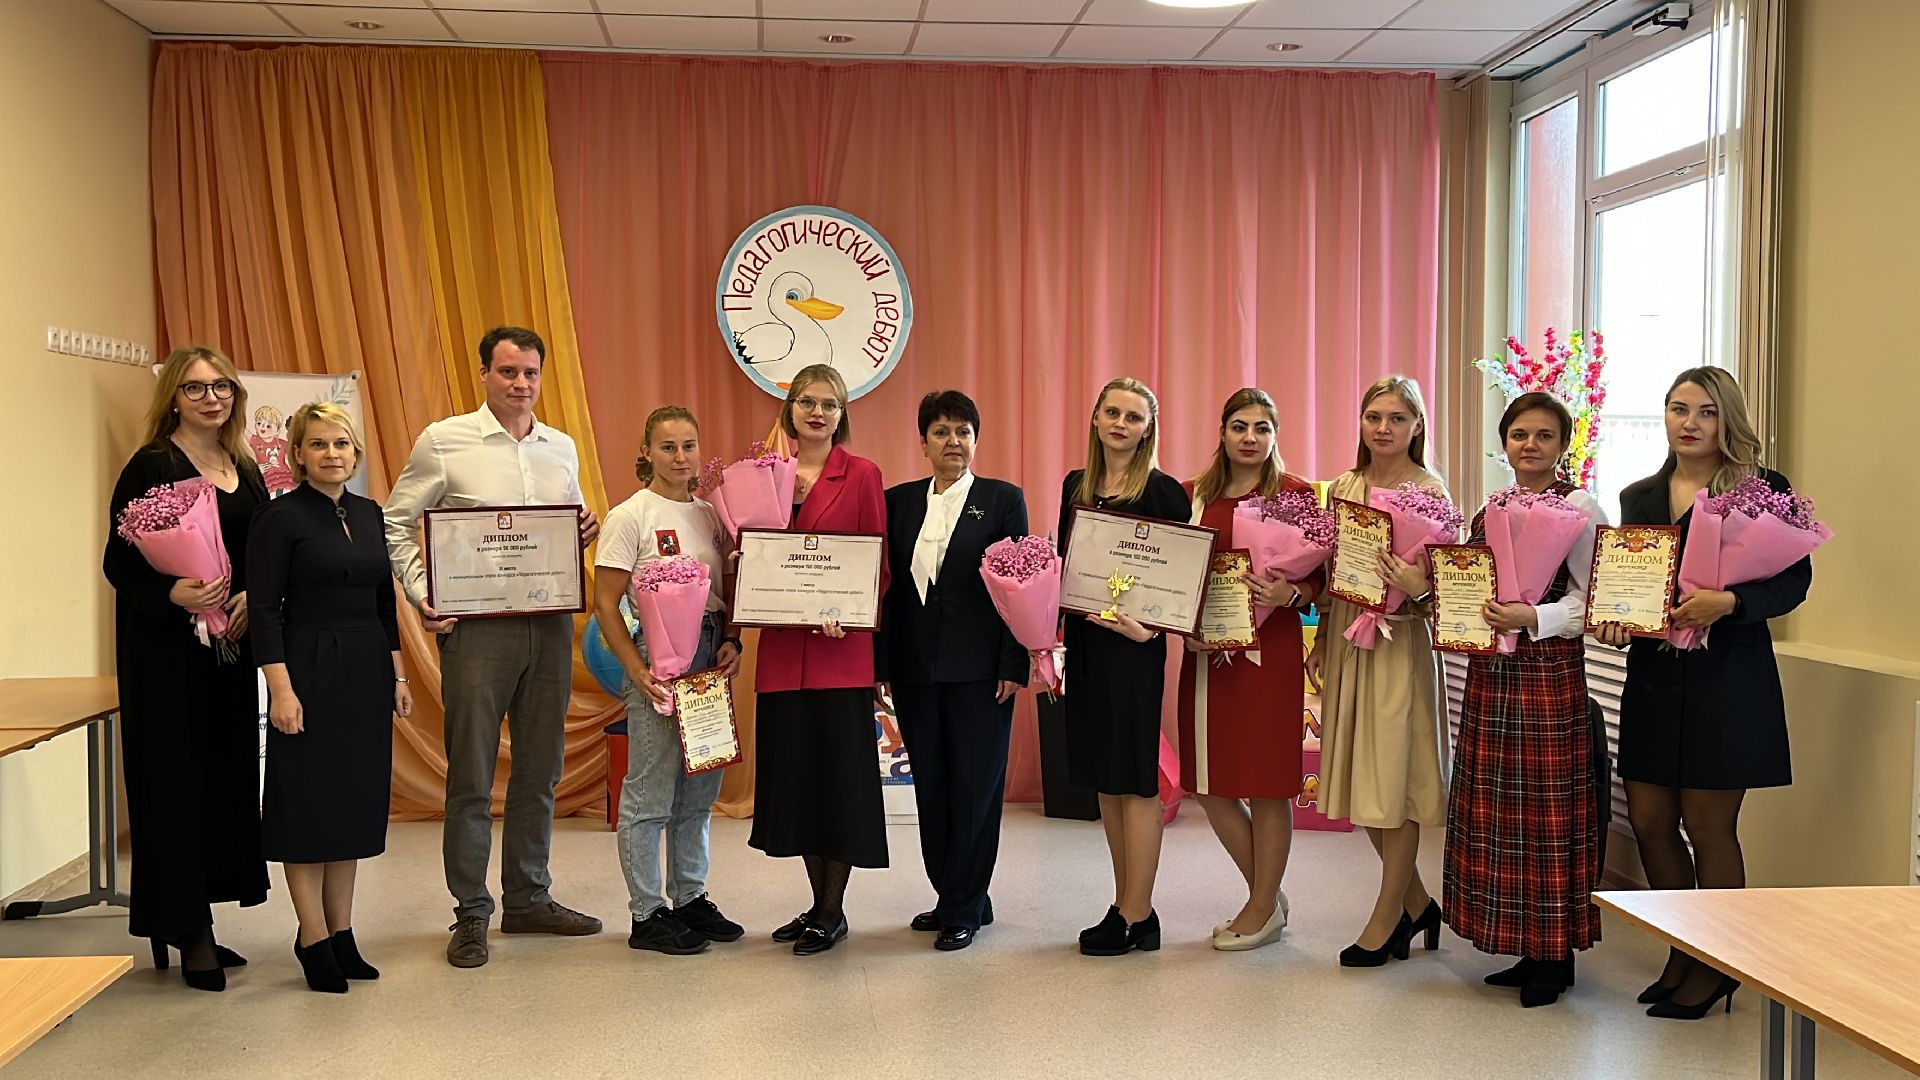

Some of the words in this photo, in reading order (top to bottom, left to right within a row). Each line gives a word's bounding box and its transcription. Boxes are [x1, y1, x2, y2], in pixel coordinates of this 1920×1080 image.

[722, 220, 890, 311] Педагогический
[862, 292, 899, 368] дебют
[483, 534, 528, 544] ДИПЛОМ
[1343, 525, 1383, 544] ДИПЛОМ
[1117, 541, 1160, 554] ДИПЛОМ
[788, 554, 831, 562] ДИПЛОМ
[1604, 554, 1663, 565] ДИПЛОМ
[1442, 572, 1487, 582] ДИПЛОМ
[684, 693, 723, 710] ДИПЛОМ
